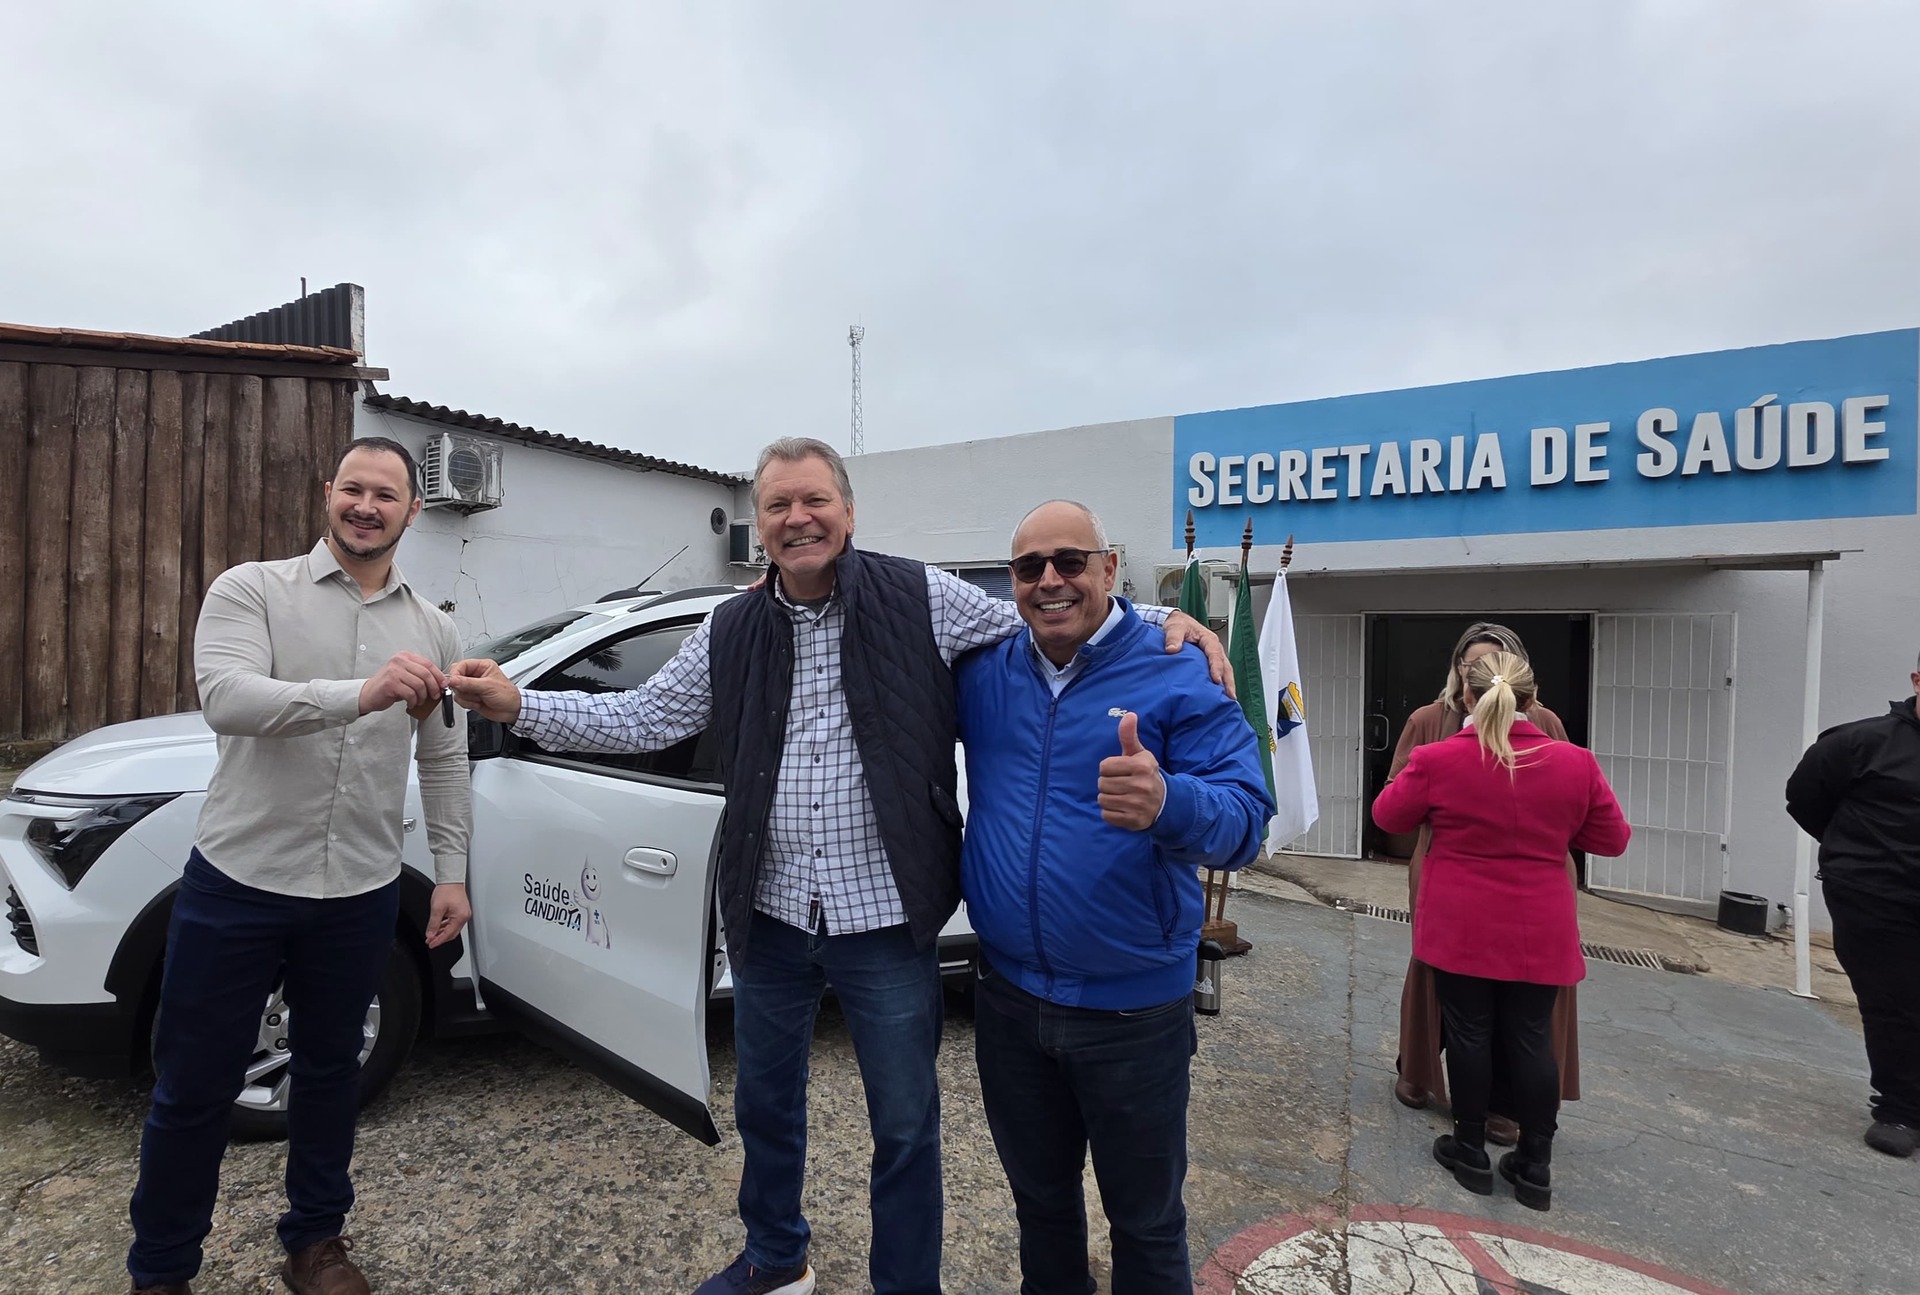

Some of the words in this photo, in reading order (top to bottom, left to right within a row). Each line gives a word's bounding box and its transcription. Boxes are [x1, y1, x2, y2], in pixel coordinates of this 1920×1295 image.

[1188, 432, 1507, 508] SECRETARIA
[1530, 421, 1611, 486] DE
[1636, 393, 1890, 478] SAÚDE
[523, 873, 570, 906] Saúde
